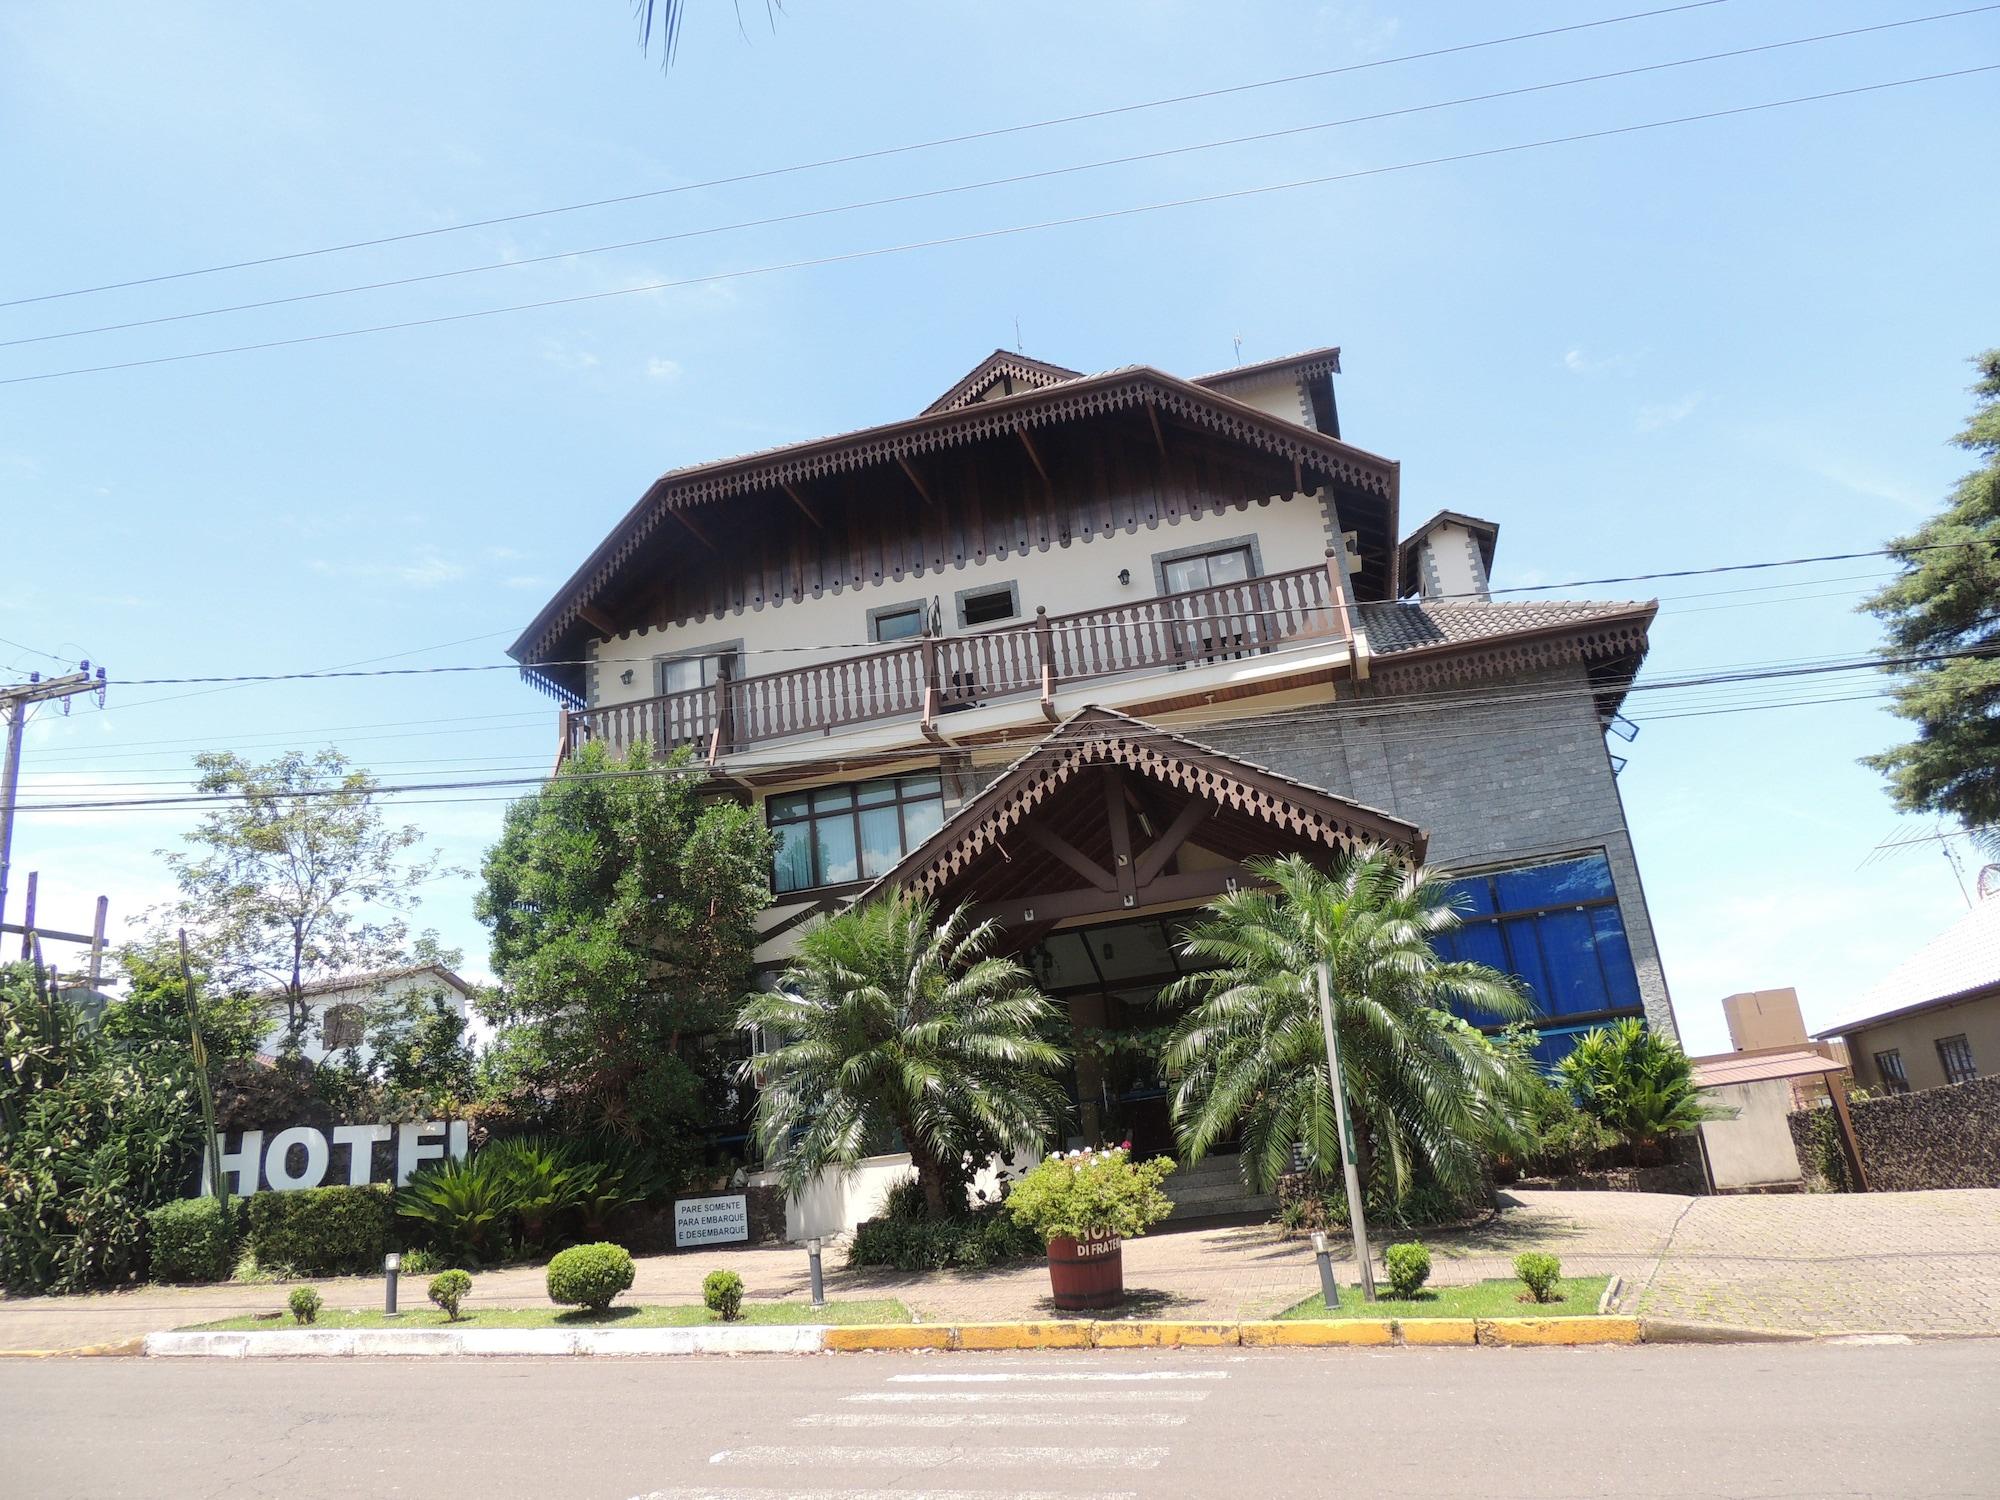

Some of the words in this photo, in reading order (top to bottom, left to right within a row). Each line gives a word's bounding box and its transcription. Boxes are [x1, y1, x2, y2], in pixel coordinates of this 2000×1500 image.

[681, 1204, 702, 1214] PARE
[704, 1201, 741, 1212] SOMENTE
[678, 1217, 700, 1228] PARA
[701, 1213, 745, 1225] EMBARQUE
[678, 1231, 684, 1240] E
[686, 1225, 745, 1239] DESEMBARQUE
[1076, 1244, 1090, 1257] DI
